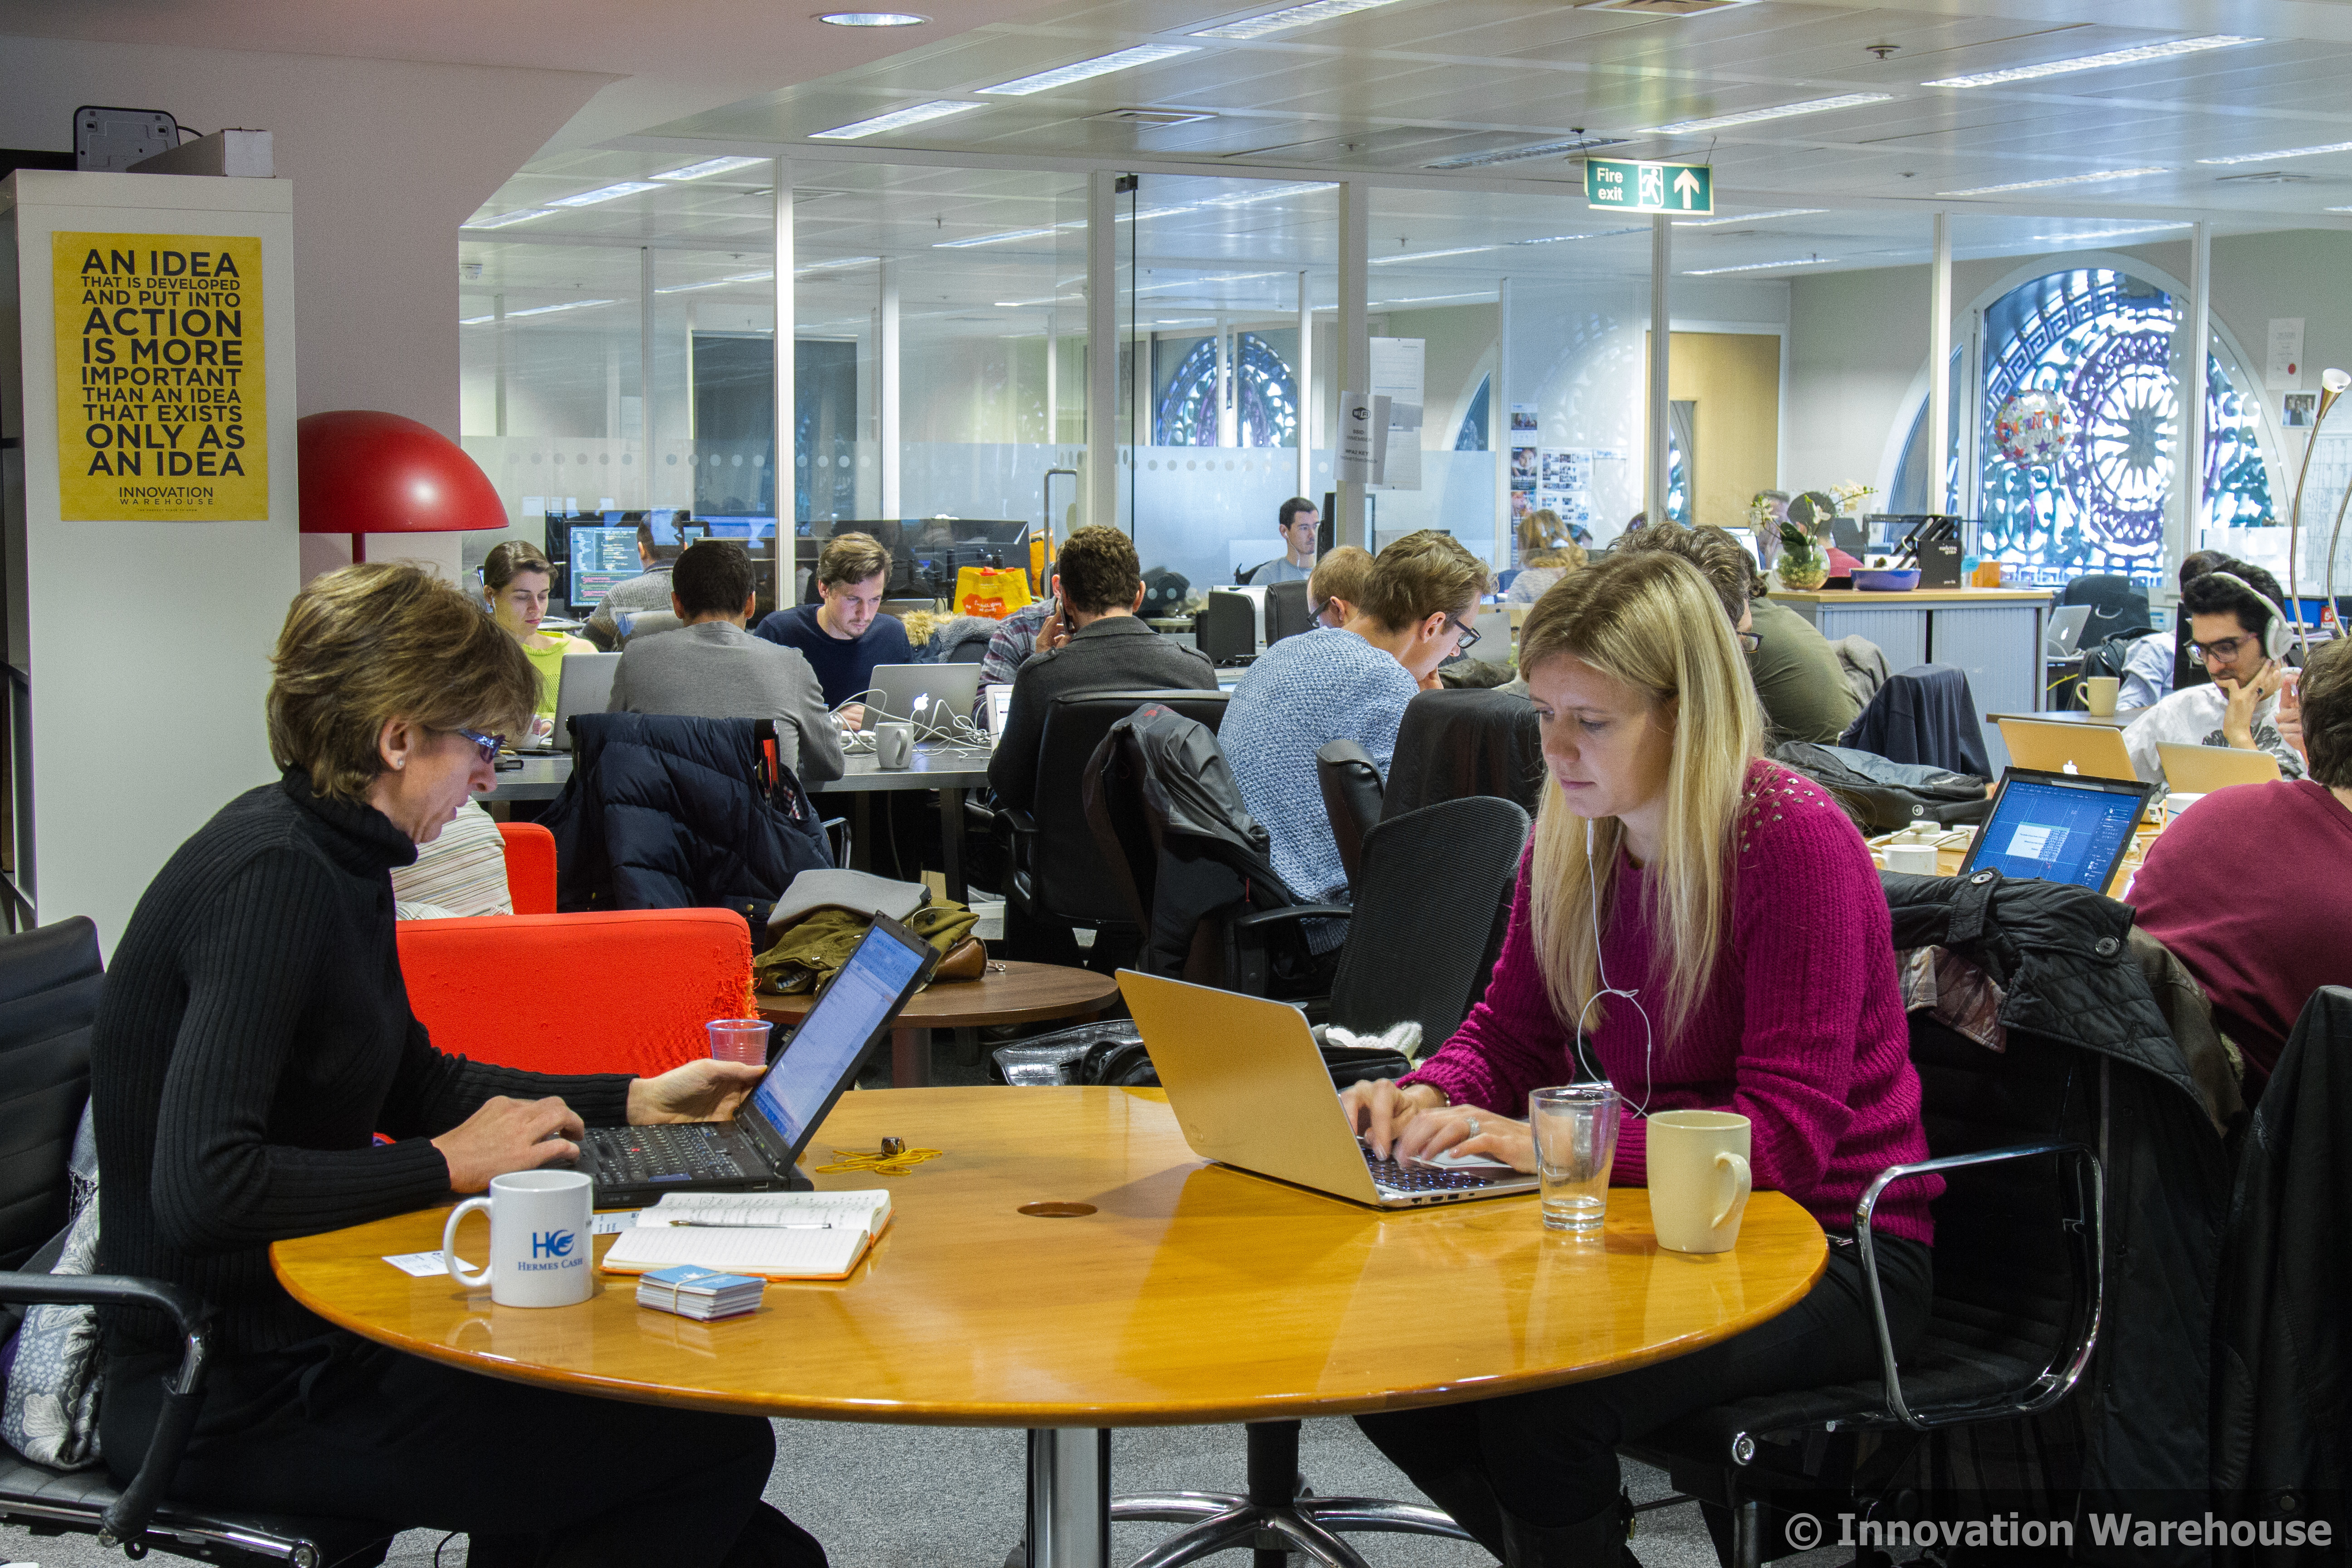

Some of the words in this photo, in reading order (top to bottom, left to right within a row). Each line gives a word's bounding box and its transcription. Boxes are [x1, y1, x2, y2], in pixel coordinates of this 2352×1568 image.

[1597, 167, 1623, 183] Fire
[1597, 186, 1623, 201] exit
[81, 249, 135, 275] AN
[151, 250, 240, 278] IDEA
[81, 276, 122, 288] THAT
[127, 277, 141, 288] IS
[147, 278, 240, 290] DEVELOPED
[82, 289, 131, 305] AND
[139, 291, 181, 306] PUT
[189, 292, 241, 308] INTO
[83, 307, 241, 338] ACTION
[83, 338, 116, 364] IS
[131, 338, 243, 366] MORE
[82, 366, 241, 386] IMPORTANT
[83, 387, 143, 402] THAN
[151, 388, 182, 402] AN
[191, 389, 242, 403] IDEA
[83, 404, 148, 421] THAT
[158, 405, 242, 422] EXISTS
[86, 423, 185, 449] ONLY
[198, 424, 245, 449] AS
[88, 451, 141, 476] AN
[157, 451, 245, 476] IDEA
[119, 487, 213, 498] INNOVATION
[518, 1261, 559, 1271] HERMES
[561, 1257, 583, 1269] CASH
